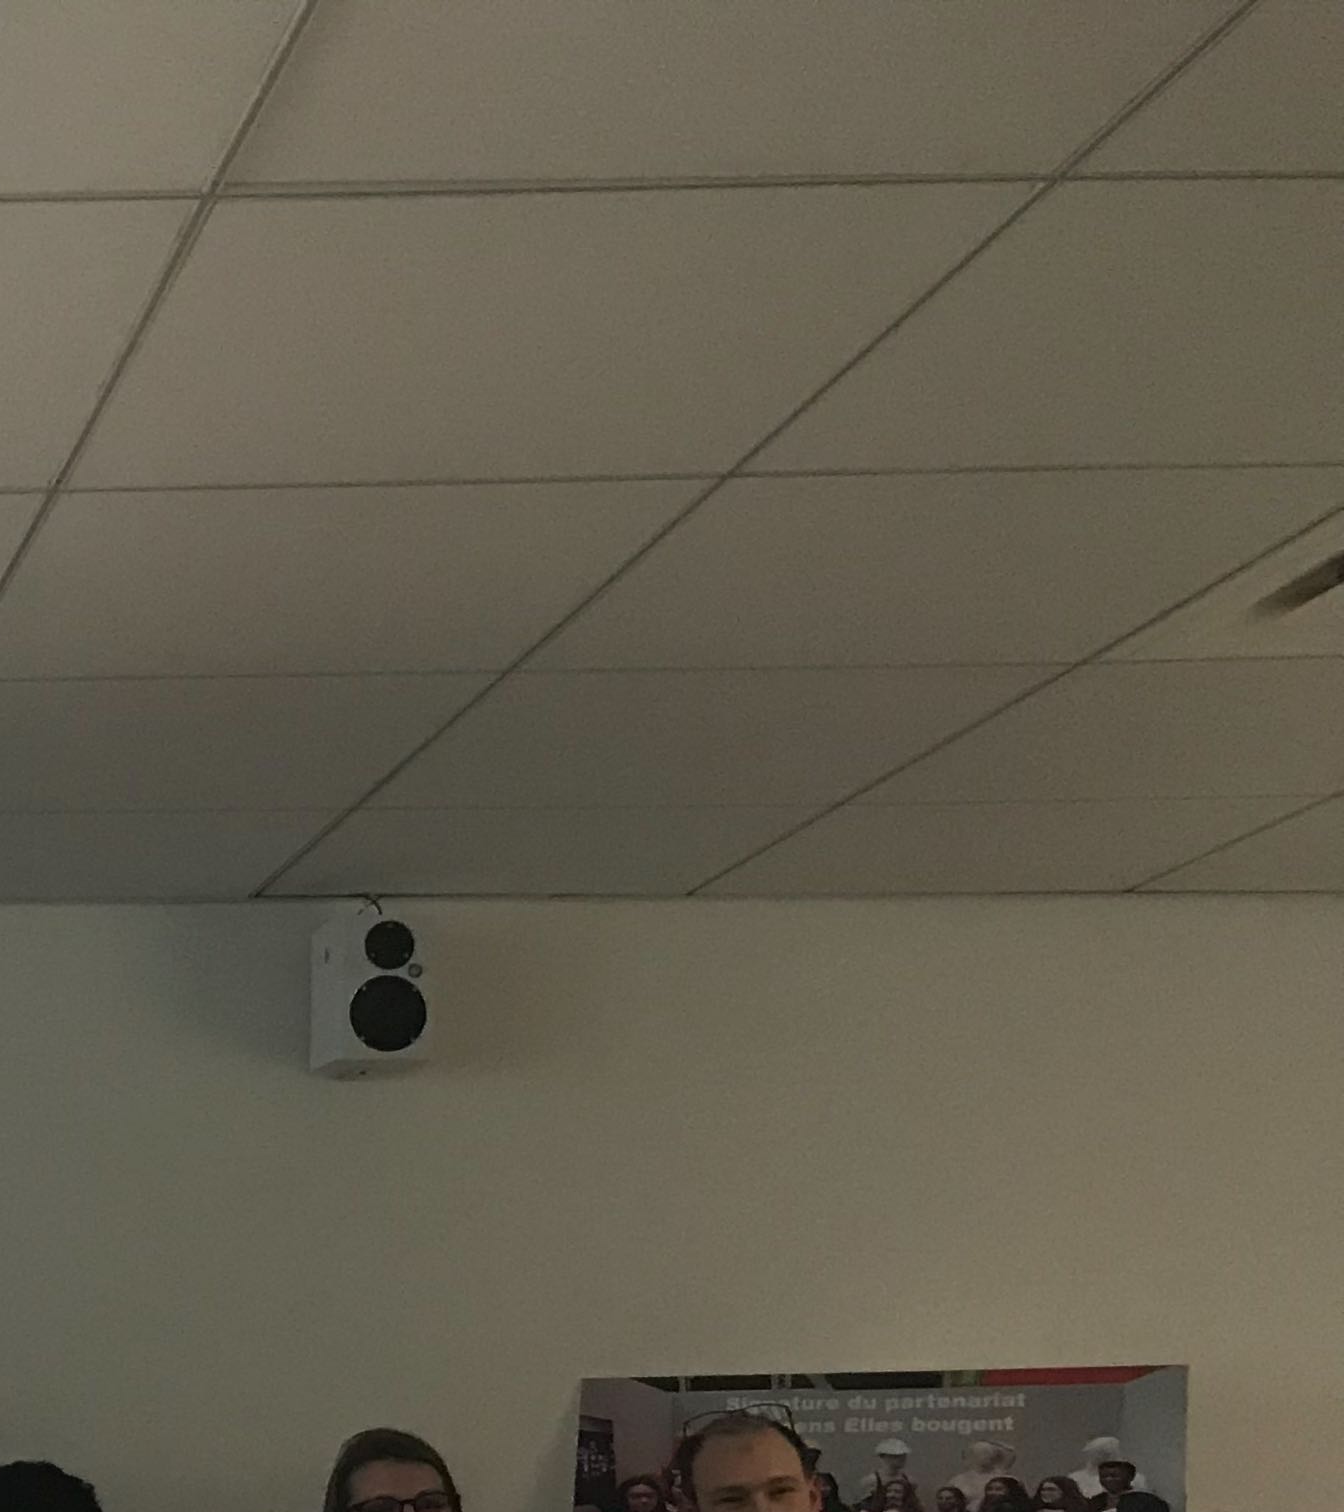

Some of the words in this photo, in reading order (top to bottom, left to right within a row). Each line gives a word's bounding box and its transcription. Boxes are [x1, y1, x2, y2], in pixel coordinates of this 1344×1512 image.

[847, 1394, 877, 1410] du
[883, 1391, 1026, 1413] partenariat
[844, 1417, 904, 1433] Elles
[912, 1415, 1014, 1435] bougent
